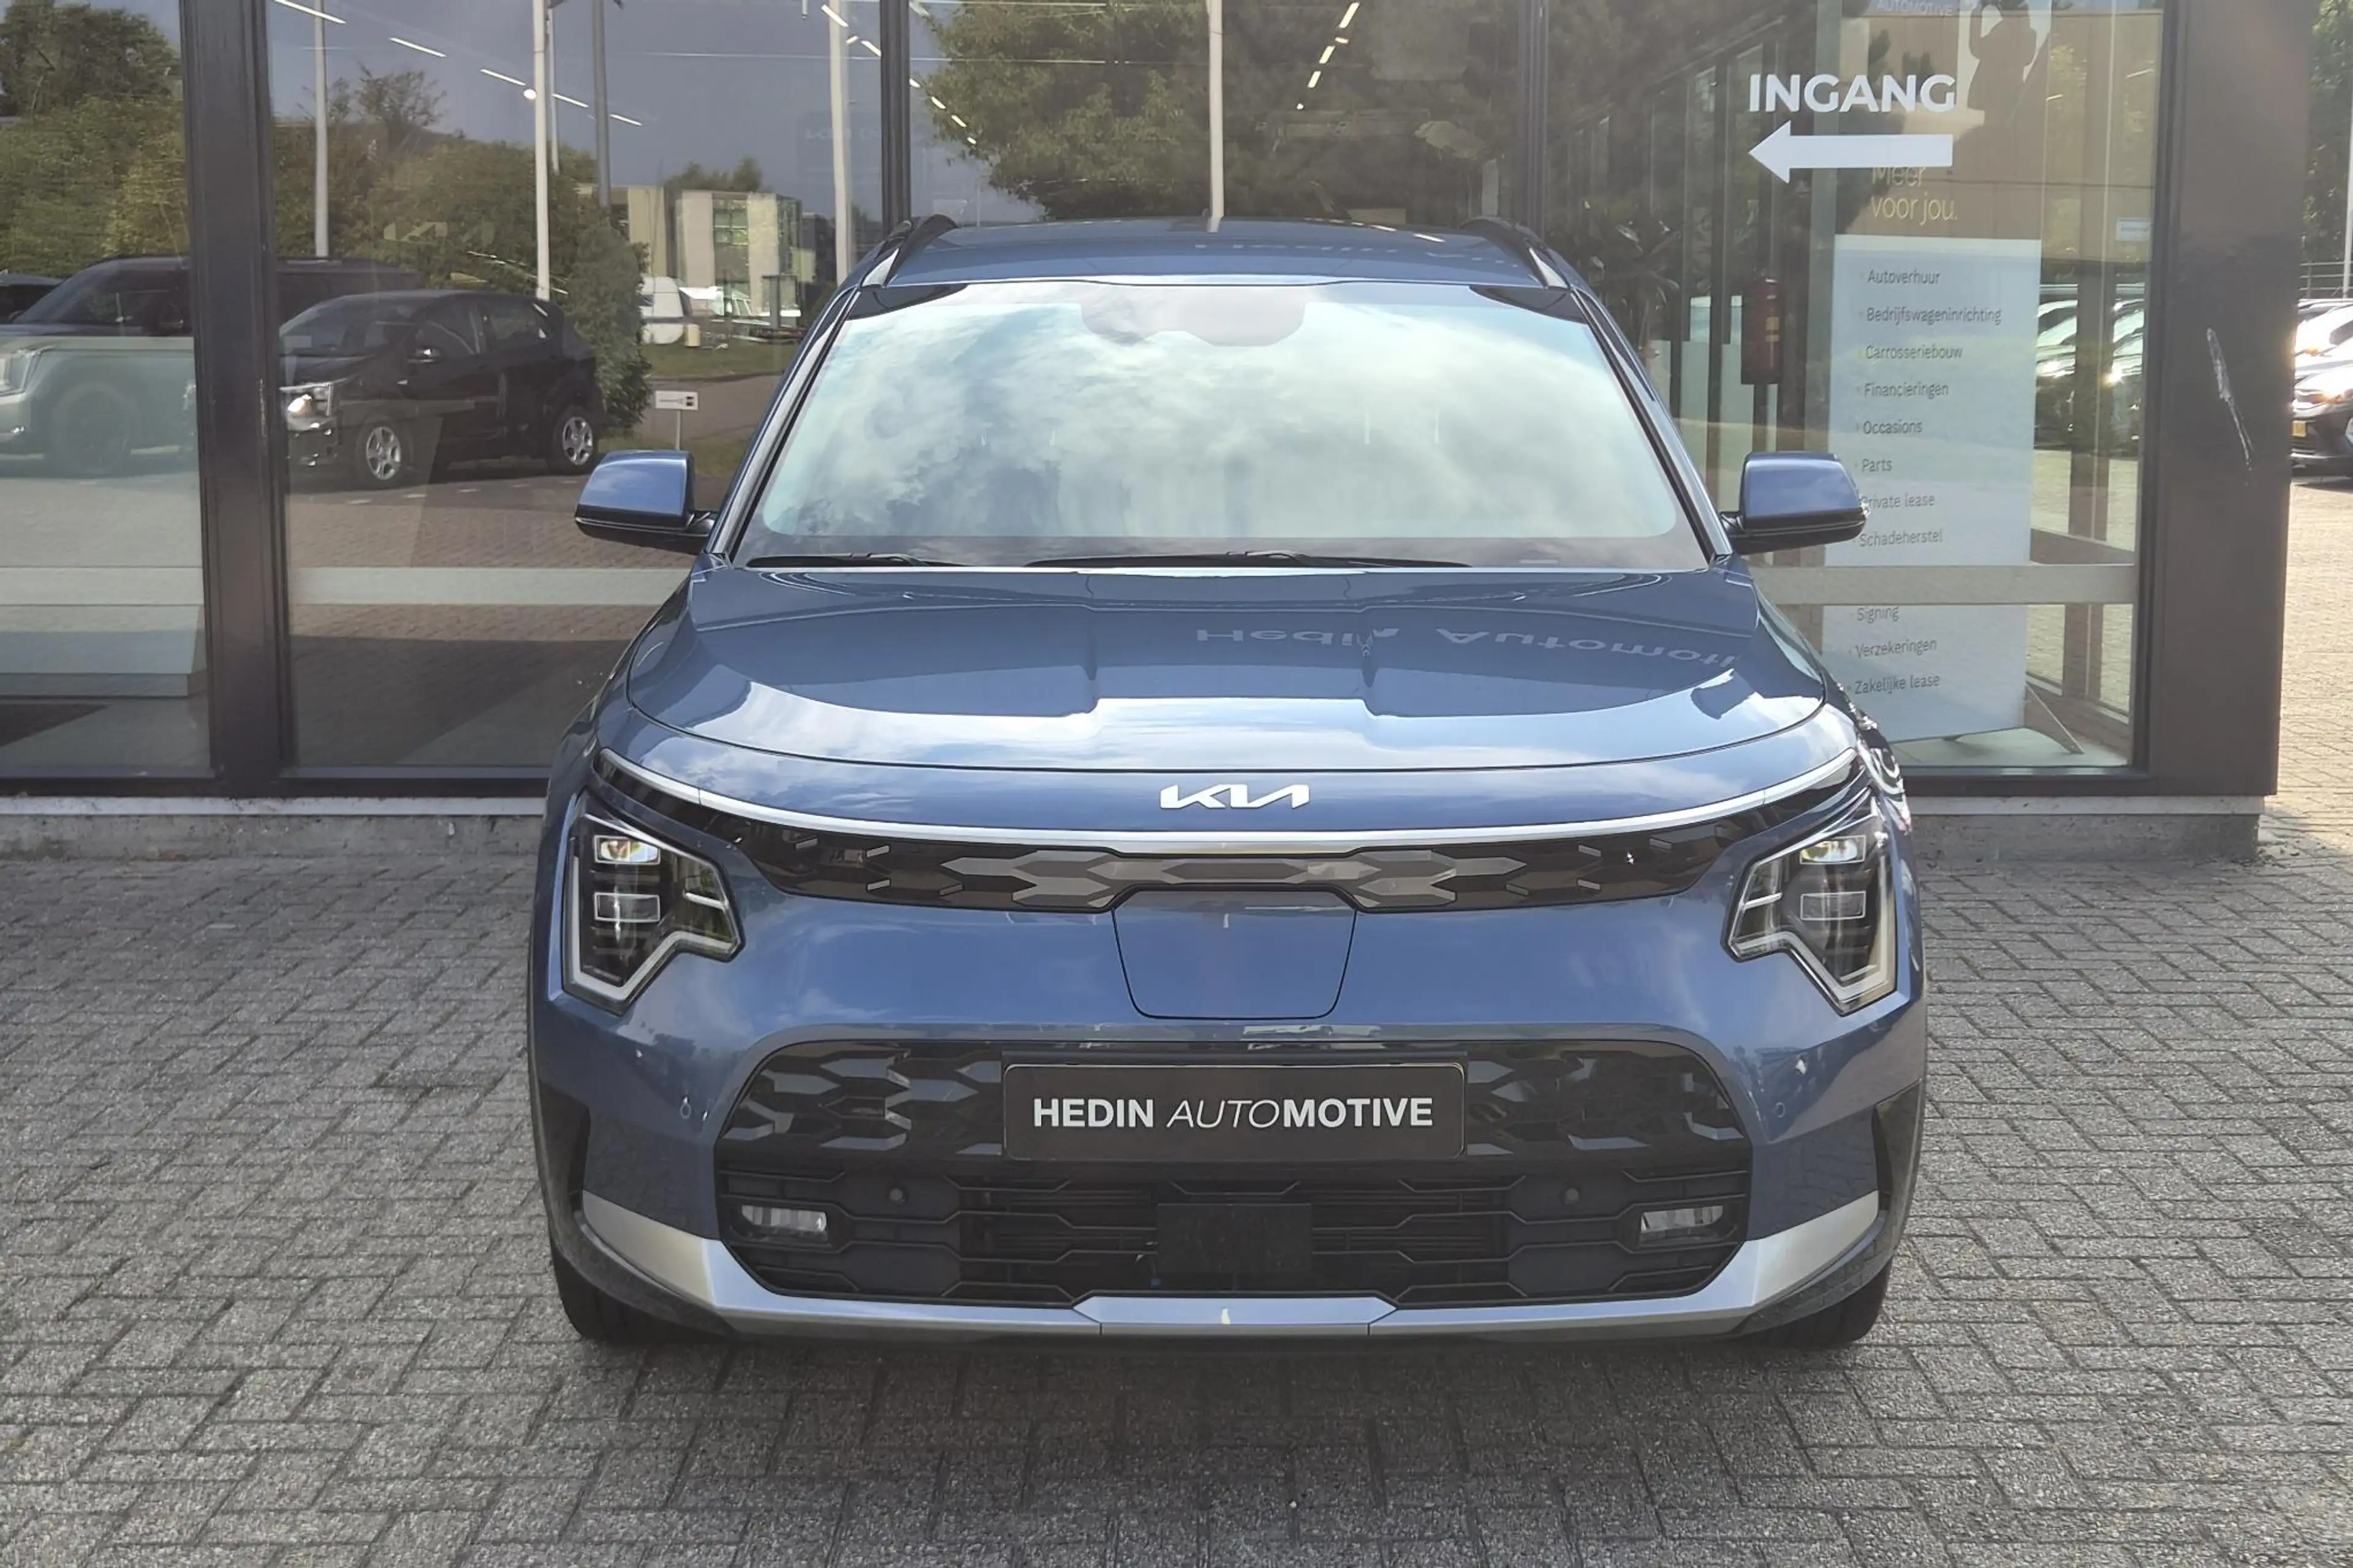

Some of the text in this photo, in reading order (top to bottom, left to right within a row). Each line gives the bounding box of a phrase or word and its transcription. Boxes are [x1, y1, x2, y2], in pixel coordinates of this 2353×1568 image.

[1748, 74, 1957, 113] INGANG
[1871, 192, 1958, 226] voor jou.
[1867, 269, 1940, 286] Autoverhuur
[1866, 307, 2002, 326] Bedrijfswageninrichting
[1865, 344, 1963, 360] Carrosseriebouw
[1864, 382, 1949, 400] Financieringen
[1863, 420, 1923, 435] Occasions
[1862, 458, 1893, 473] Parts
[1904, 493, 1936, 508] lease
[1859, 528, 1943, 547] Schadeherstel
[1857, 605, 1900, 624] Signing
[1855, 638, 1937, 659] Verzekeringen
[1854, 674, 1941, 695] Zakelijke lease
[1160, 784, 1311, 809] KIA
[1033, 1097, 1434, 1128] HEDIN AUTOMOTIVE
